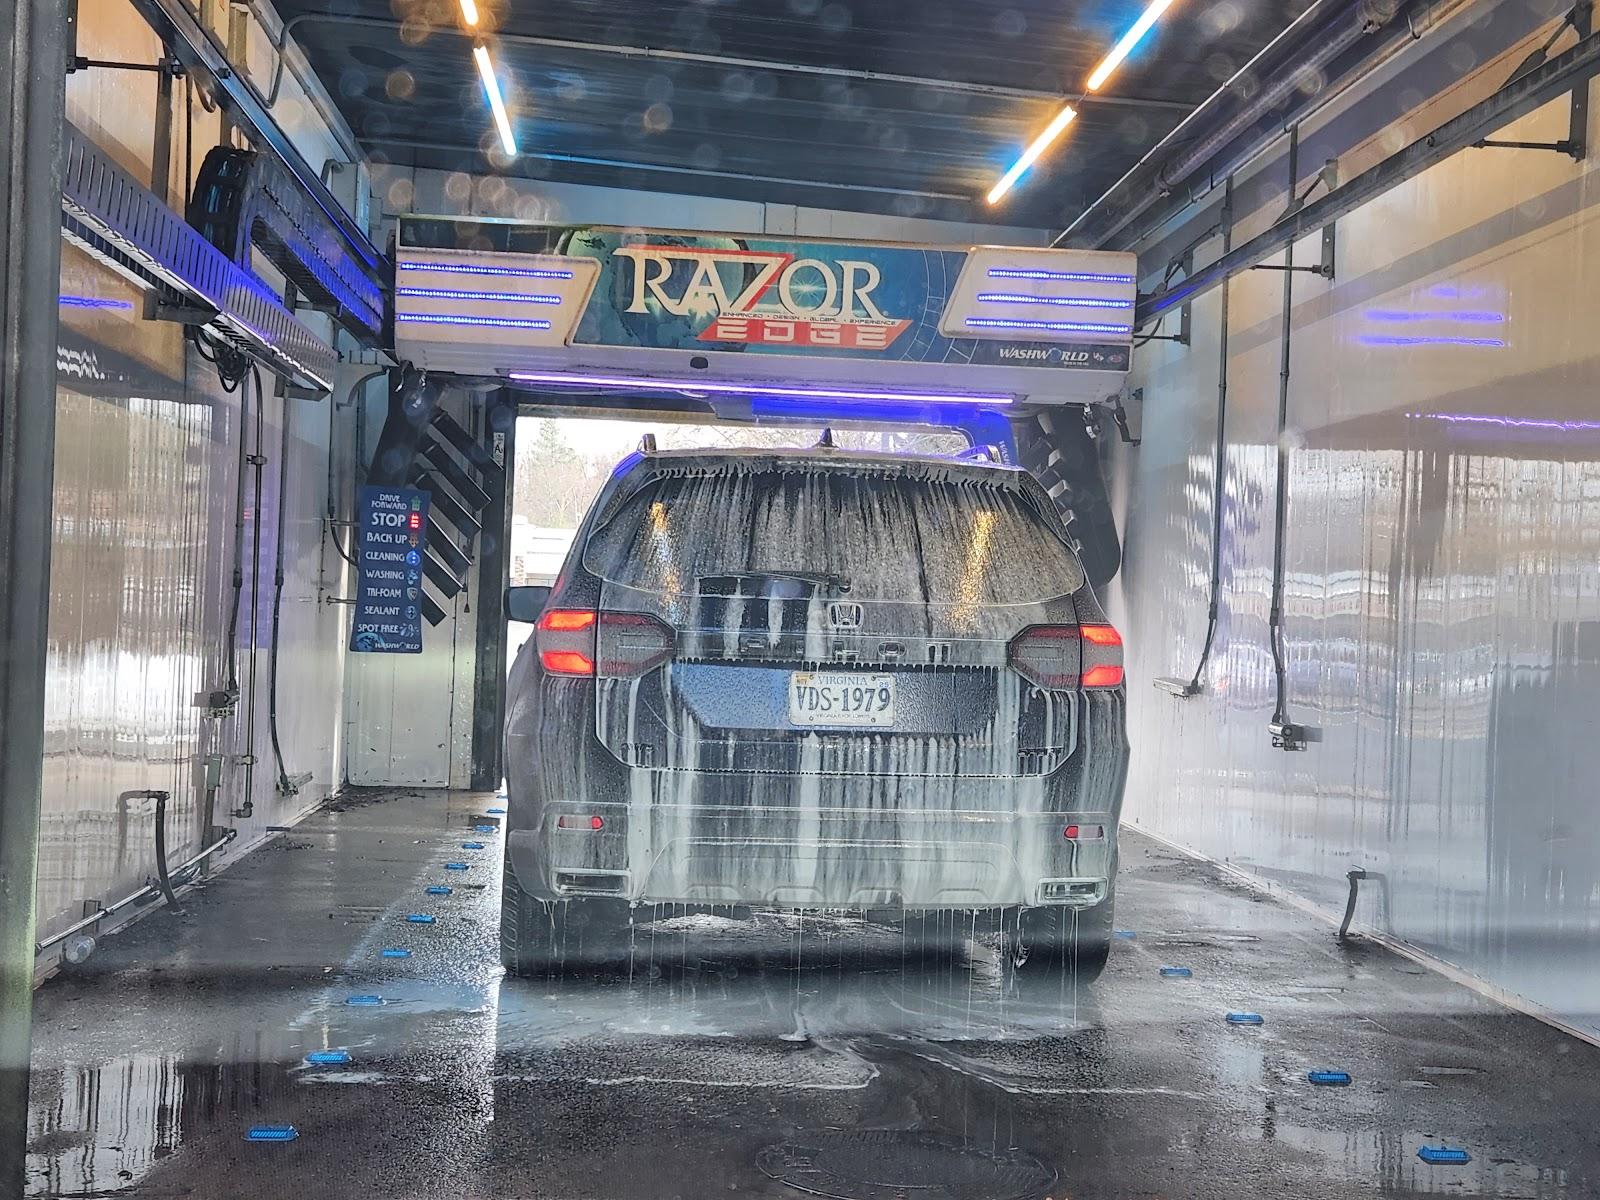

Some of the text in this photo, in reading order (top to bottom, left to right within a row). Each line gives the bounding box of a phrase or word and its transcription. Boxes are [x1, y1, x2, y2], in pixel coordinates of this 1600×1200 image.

[613, 247, 889, 319] RAZOR
[716, 318, 887, 347] EDGE
[380, 494, 401, 502] DRIVE
[371, 500, 408, 510] FORWARD
[371, 512, 406, 527] STOP
[367, 532, 408, 544] BACK UP
[365, 551, 405, 562] CLEANING
[365, 569, 405, 580] WASHING
[366, 587, 402, 598] TRI-FOAM
[364, 605, 400, 615] SEALANT
[357, 624, 400, 634] SPOT FREE
[818, 676, 868, 686] VIRGINIA
[796, 686, 891, 712] VDS-1979
